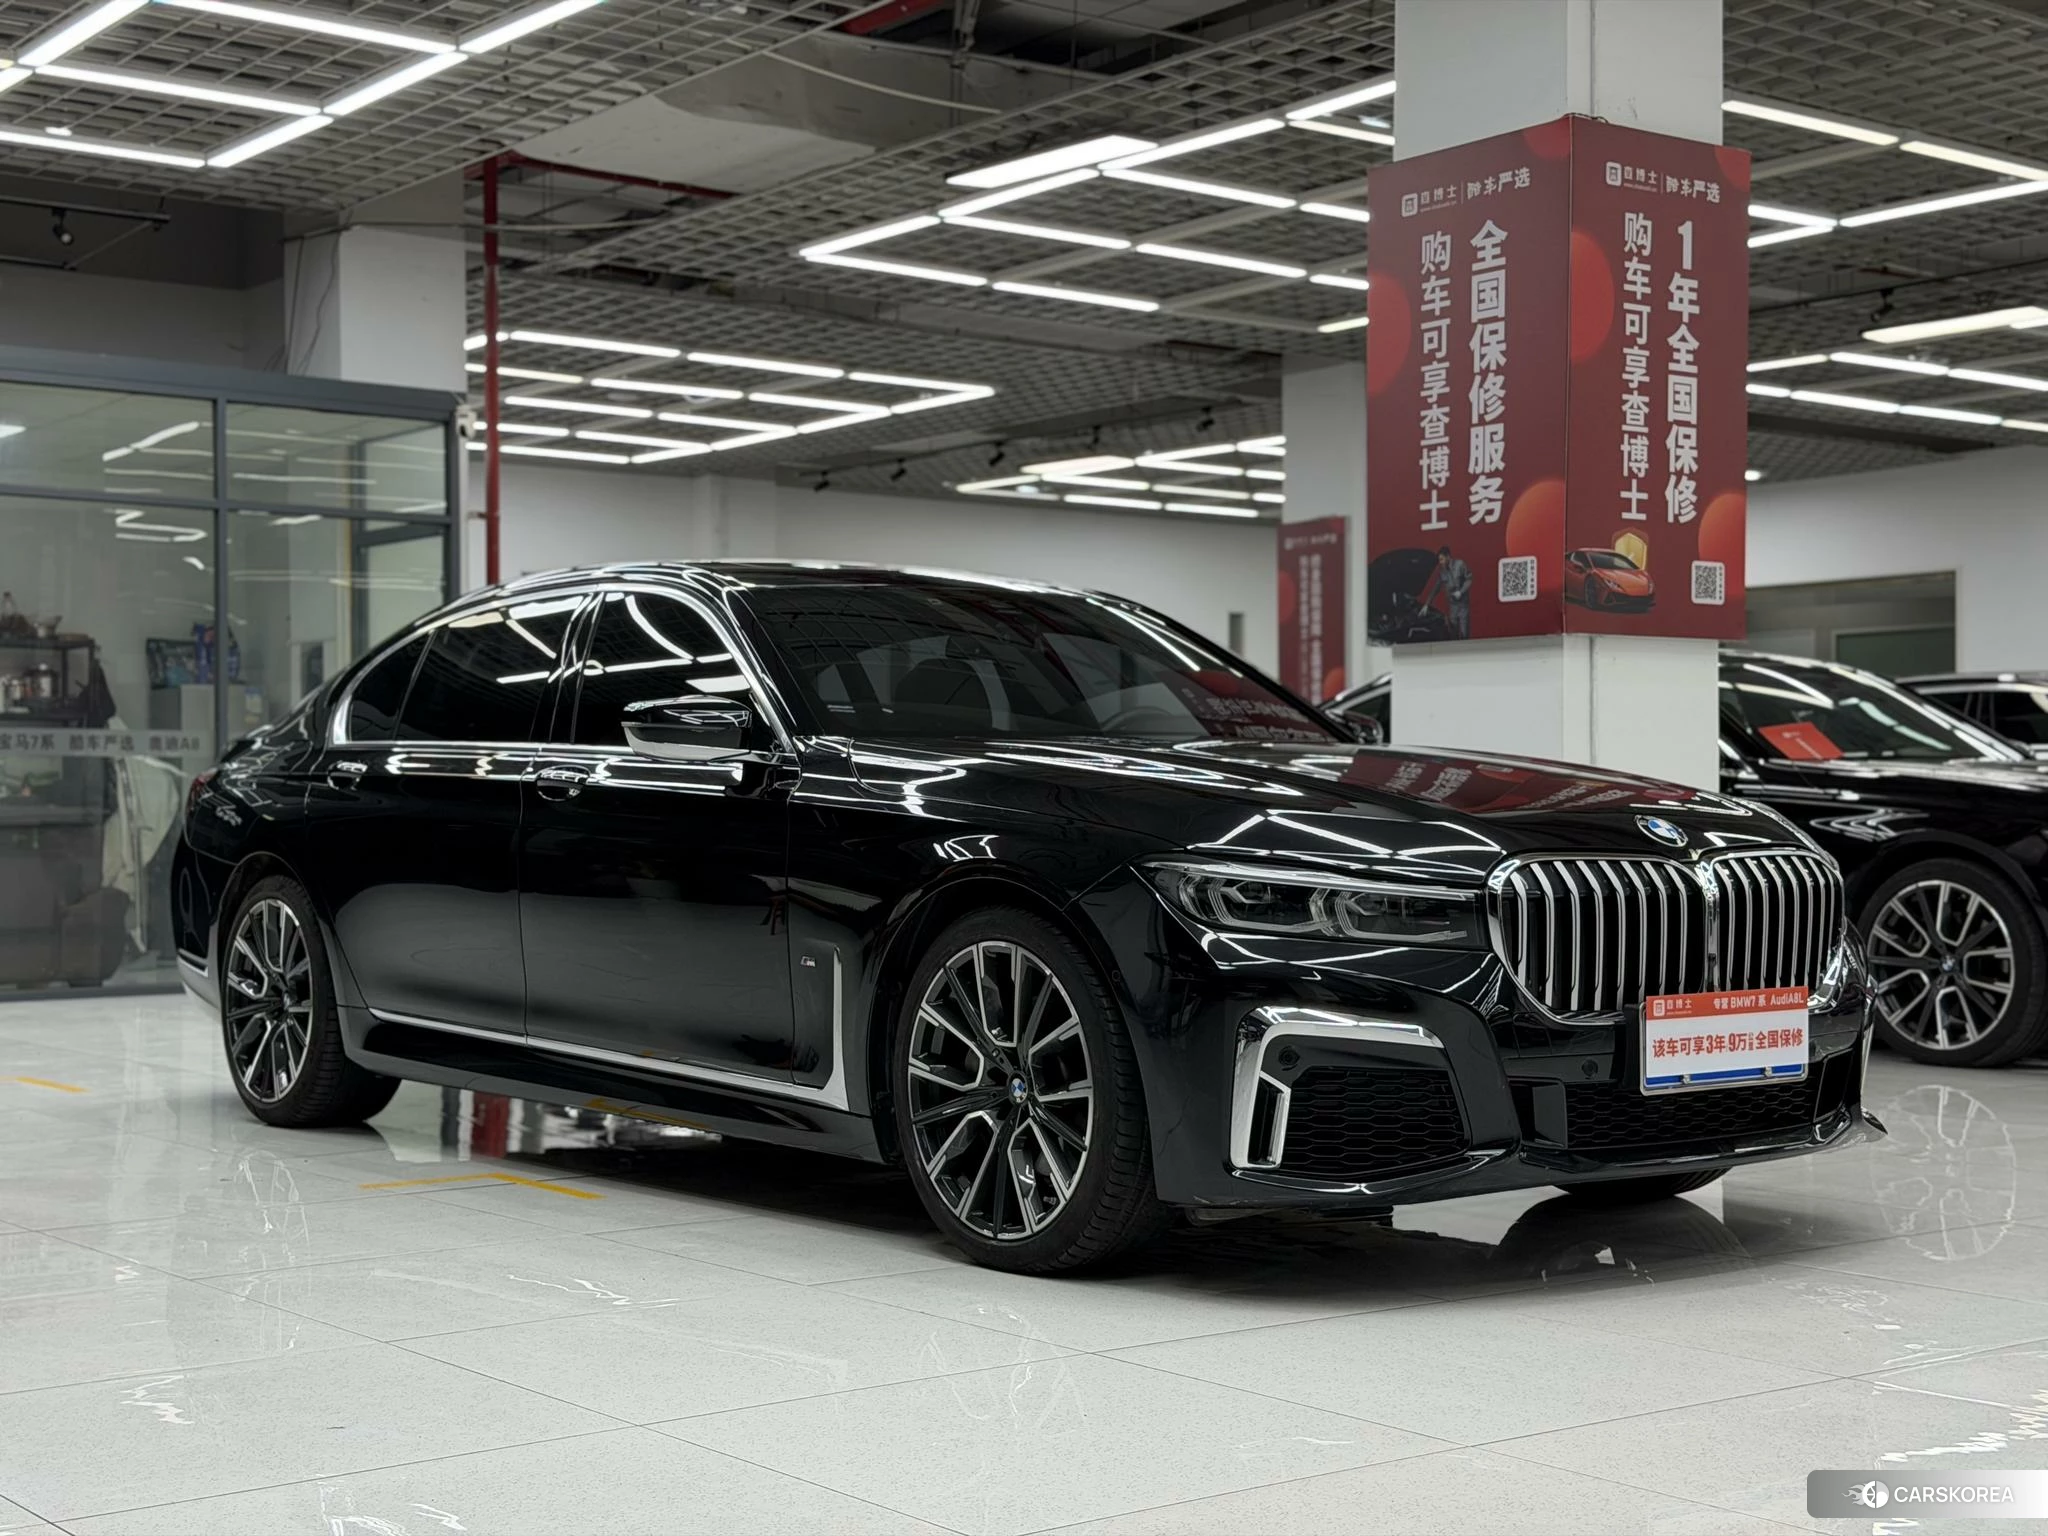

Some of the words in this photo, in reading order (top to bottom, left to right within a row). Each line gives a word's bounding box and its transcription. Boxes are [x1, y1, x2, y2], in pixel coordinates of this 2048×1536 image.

[1419, 230, 1452, 531] 购车可享查博士
[1468, 219, 1508, 525] 全国保修服务
[1620, 212, 1652, 521] 购车可享查博士
[1665, 220, 1700, 524] 1年全国保修
